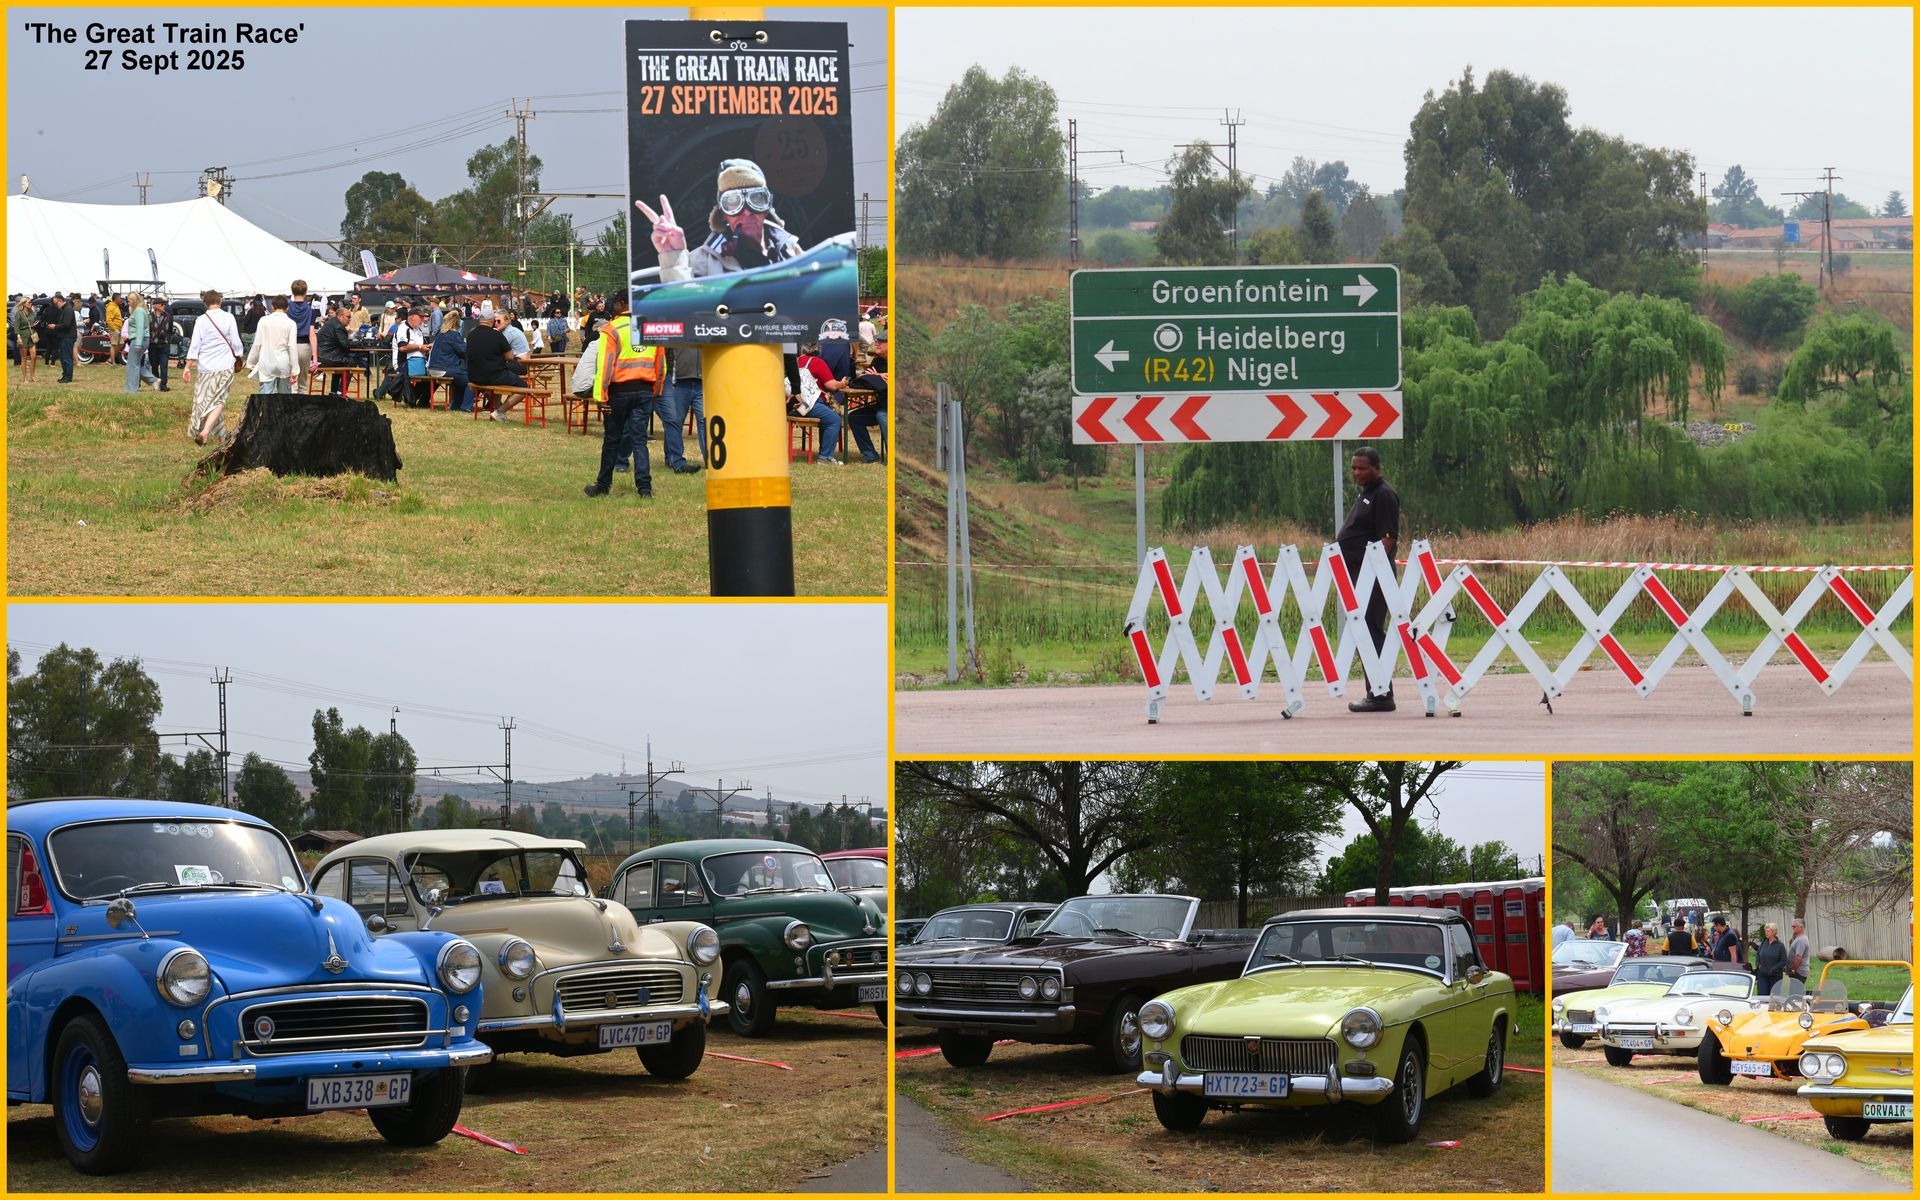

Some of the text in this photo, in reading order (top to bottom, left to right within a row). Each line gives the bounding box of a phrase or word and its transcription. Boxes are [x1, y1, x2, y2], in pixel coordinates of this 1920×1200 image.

[638, 55, 839, 82] THE GREAT TRAIN RACE
[641, 85, 838, 116] 27 SEPTEMBER 2025
[1152, 278, 1329, 304] Groenfontein
[645, 324, 682, 333] MOTUL
[694, 324, 727, 336] tixsa
[1197, 325, 1345, 354] Heidelberg
[1144, 356, 1299, 386] (R42) Nigel
[601, 1024, 670, 1044] LVC470 GP
[1761, 1064, 1771, 1074] GP
[309, 1078, 409, 1105] LXB338 GP
[1206, 1075, 1287, 1094] HXT723 GP
[1864, 1104, 1906, 1117] CORVAIR
